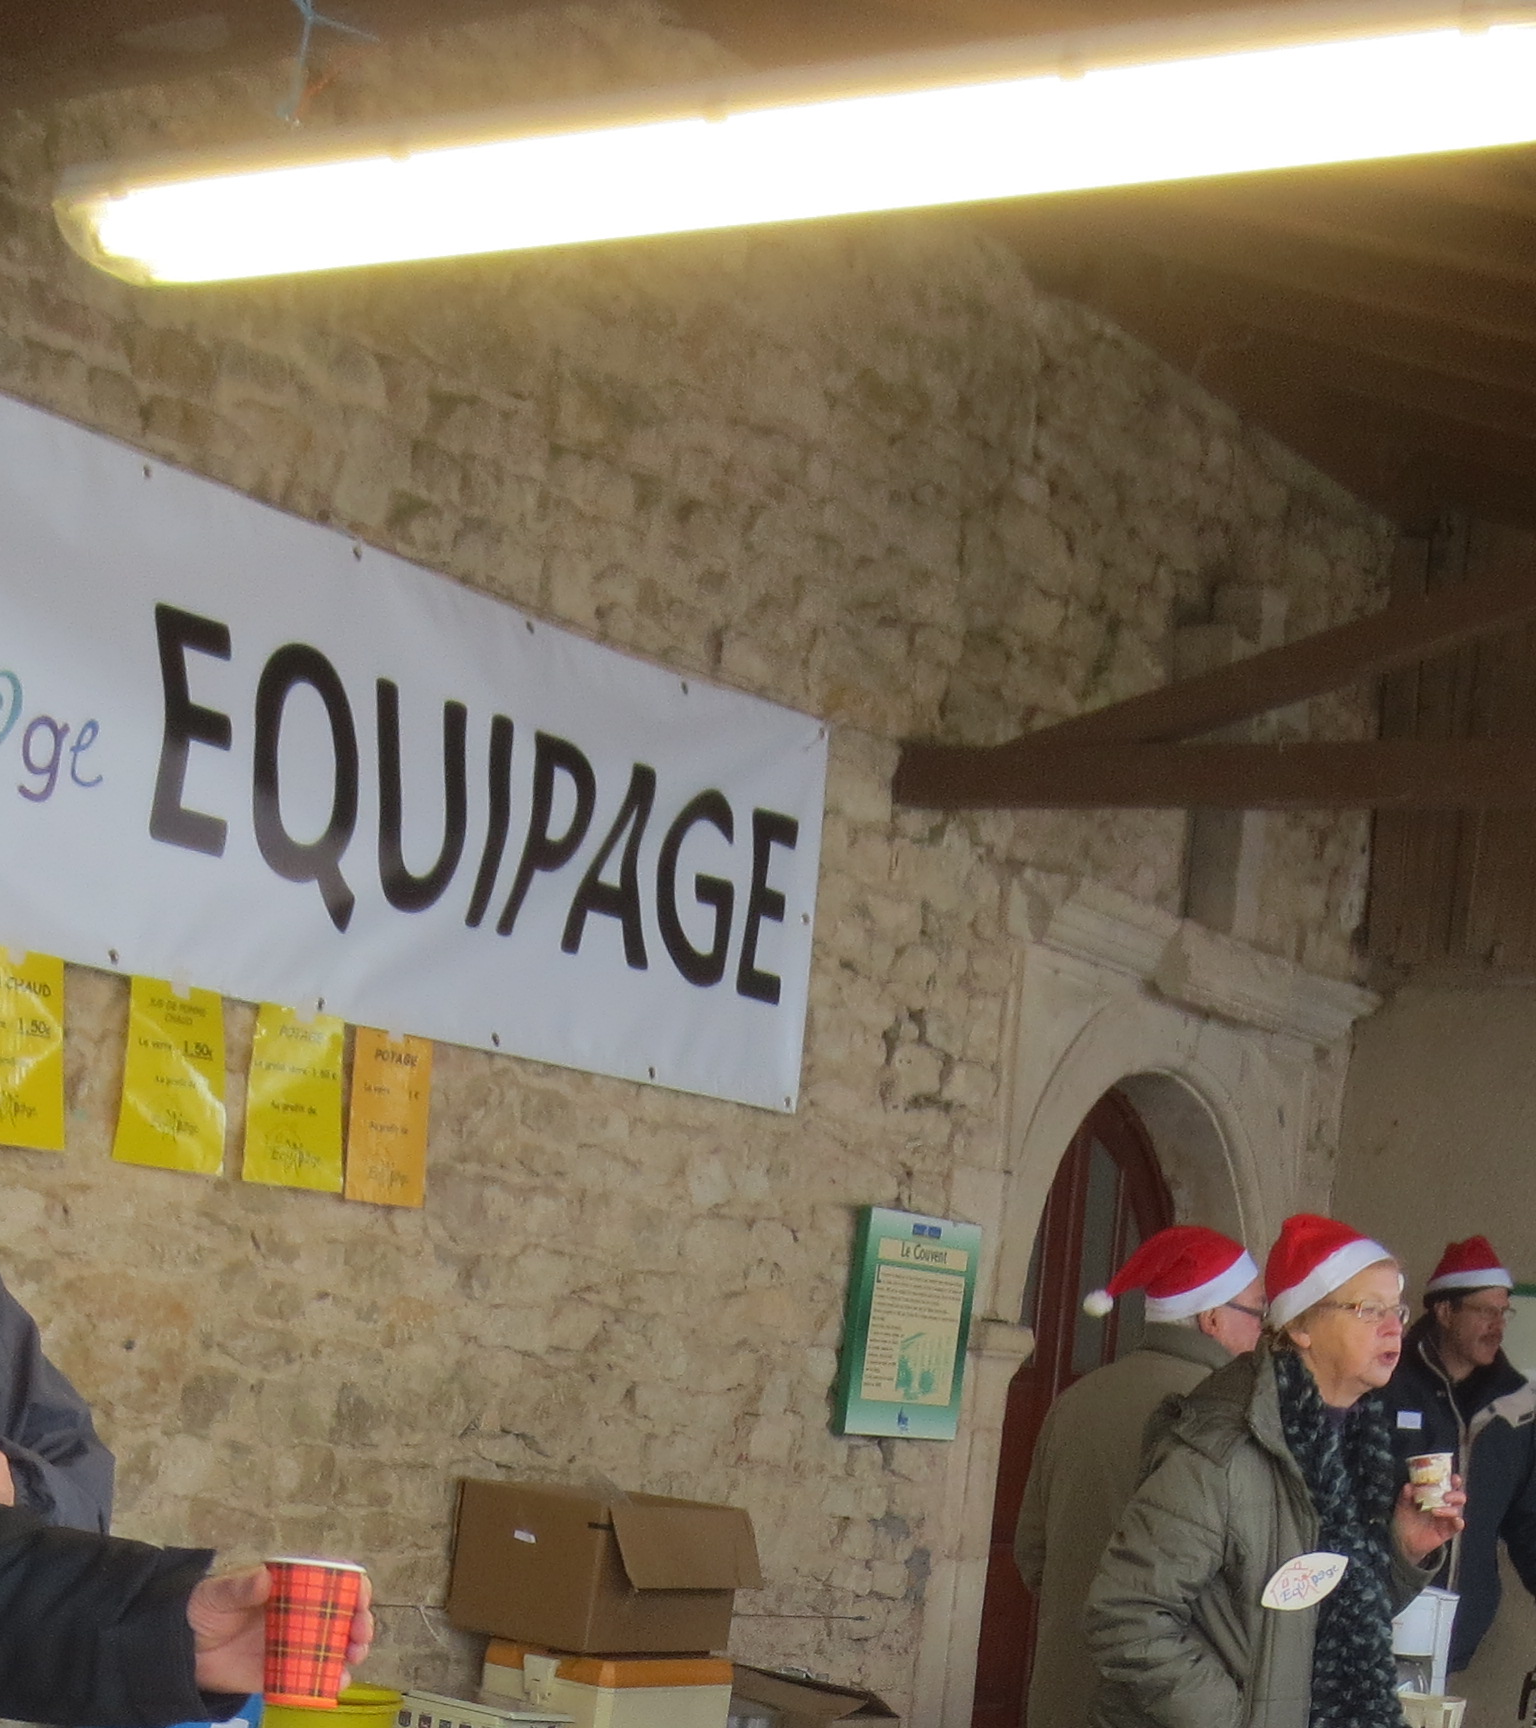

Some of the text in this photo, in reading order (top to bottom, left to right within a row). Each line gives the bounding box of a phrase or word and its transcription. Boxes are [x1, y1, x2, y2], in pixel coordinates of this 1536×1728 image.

[147, 601, 799, 1006] EQUIPAGE
[5, 977, 51, 998] CHAUD
[374, 1049, 419, 1067] POTAGE
[913, 1243, 947, 1265] Couvent
